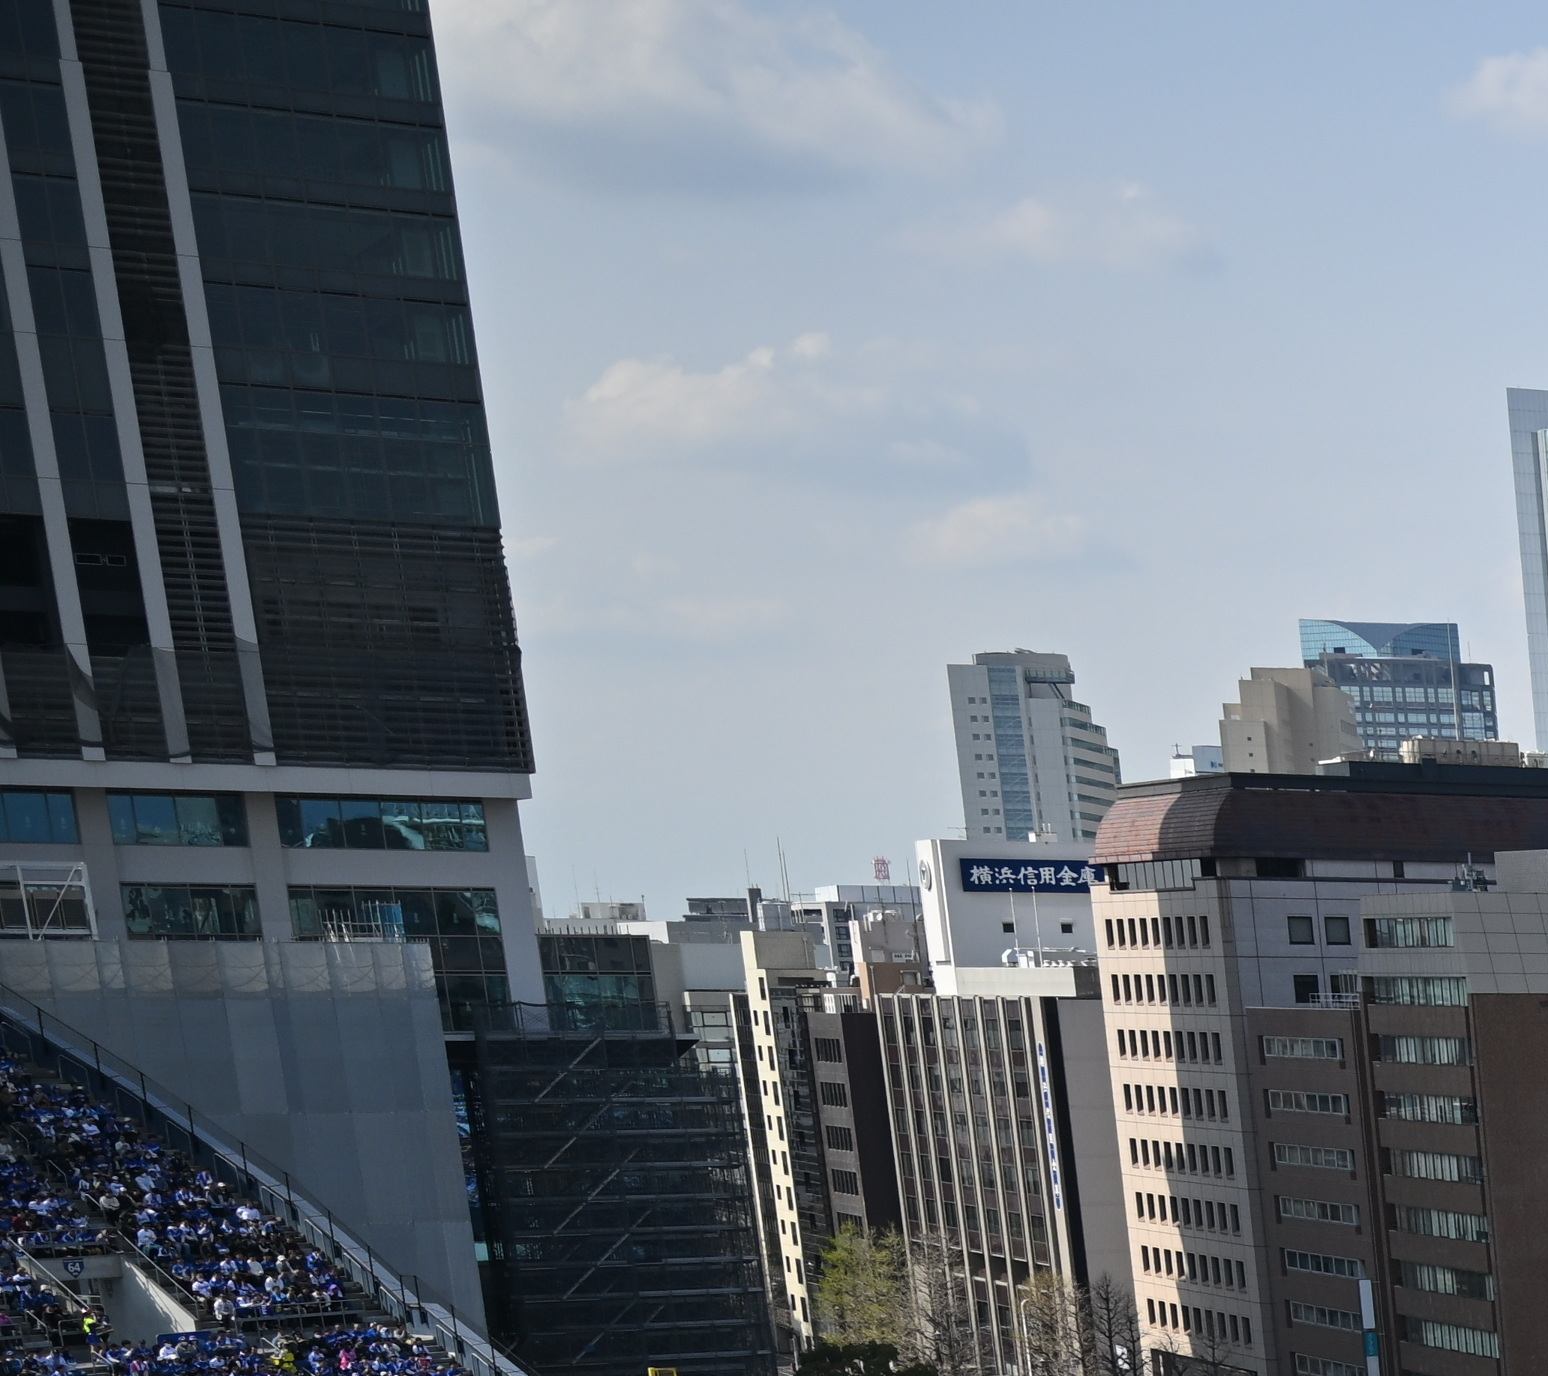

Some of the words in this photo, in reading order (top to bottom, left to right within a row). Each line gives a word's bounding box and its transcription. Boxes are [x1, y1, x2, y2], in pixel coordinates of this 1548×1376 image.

[970, 865, 1098, 886] 横浜信用金庫
